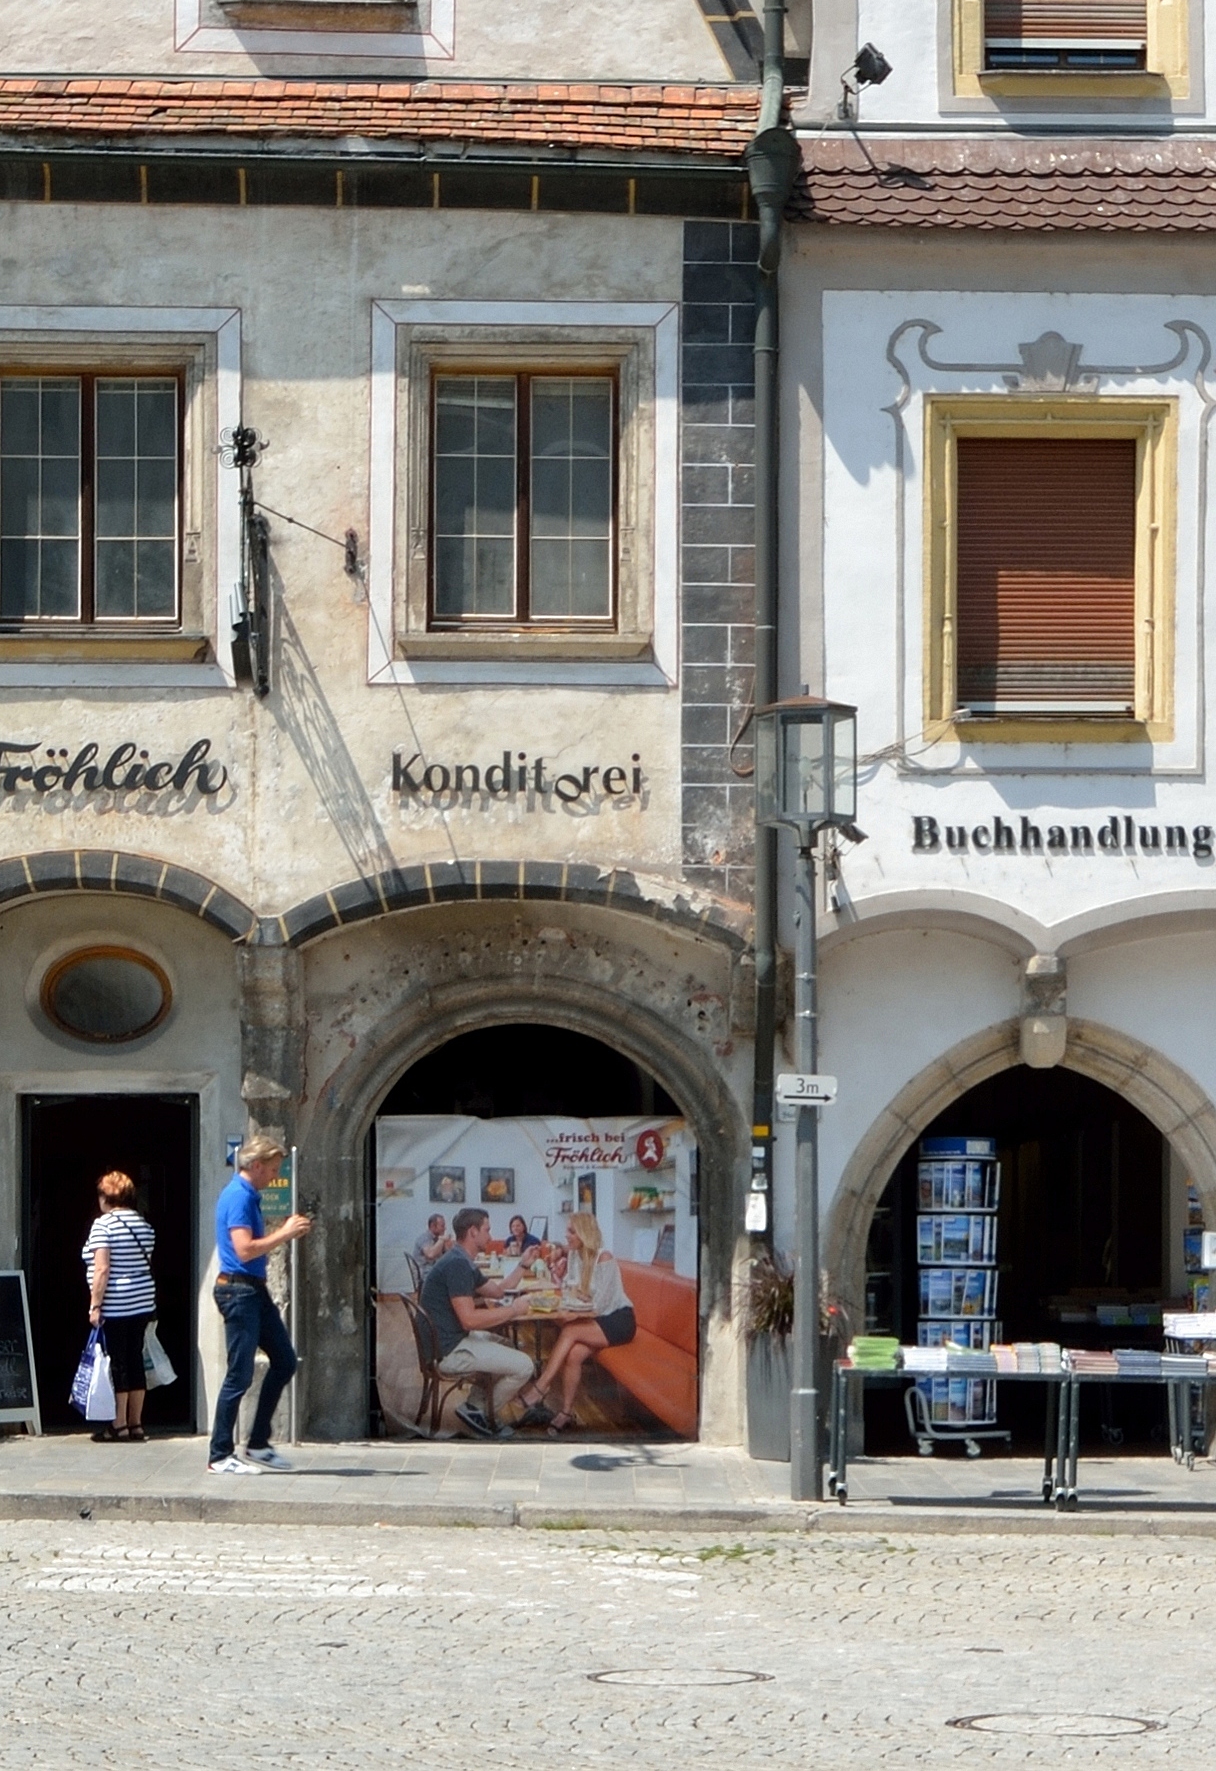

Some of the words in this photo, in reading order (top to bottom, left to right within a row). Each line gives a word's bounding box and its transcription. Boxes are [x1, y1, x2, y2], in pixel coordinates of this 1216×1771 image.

[391, 751, 644, 801] Konditorei
[911, 815, 1214, 858] Buchhandlung
[796, 1078, 819, 1094] 3m
[604, 1132, 626, 1143] bei
[545, 1146, 628, 1168] Fröhlich
